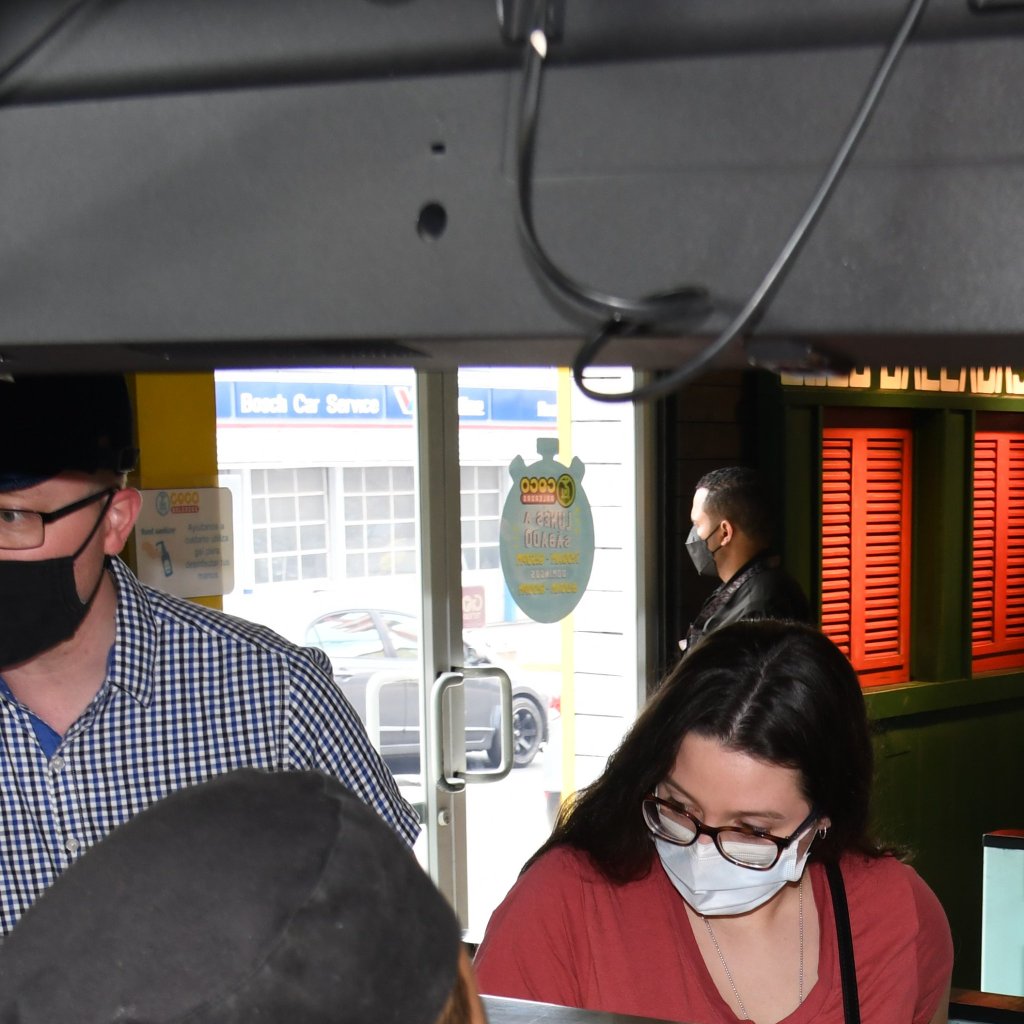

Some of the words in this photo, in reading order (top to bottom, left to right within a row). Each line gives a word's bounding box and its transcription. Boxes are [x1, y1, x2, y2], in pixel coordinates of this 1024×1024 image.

[240, 392, 288, 414] Bosch
[293, 393, 320, 414] Car
[326, 393, 380, 414] Service
